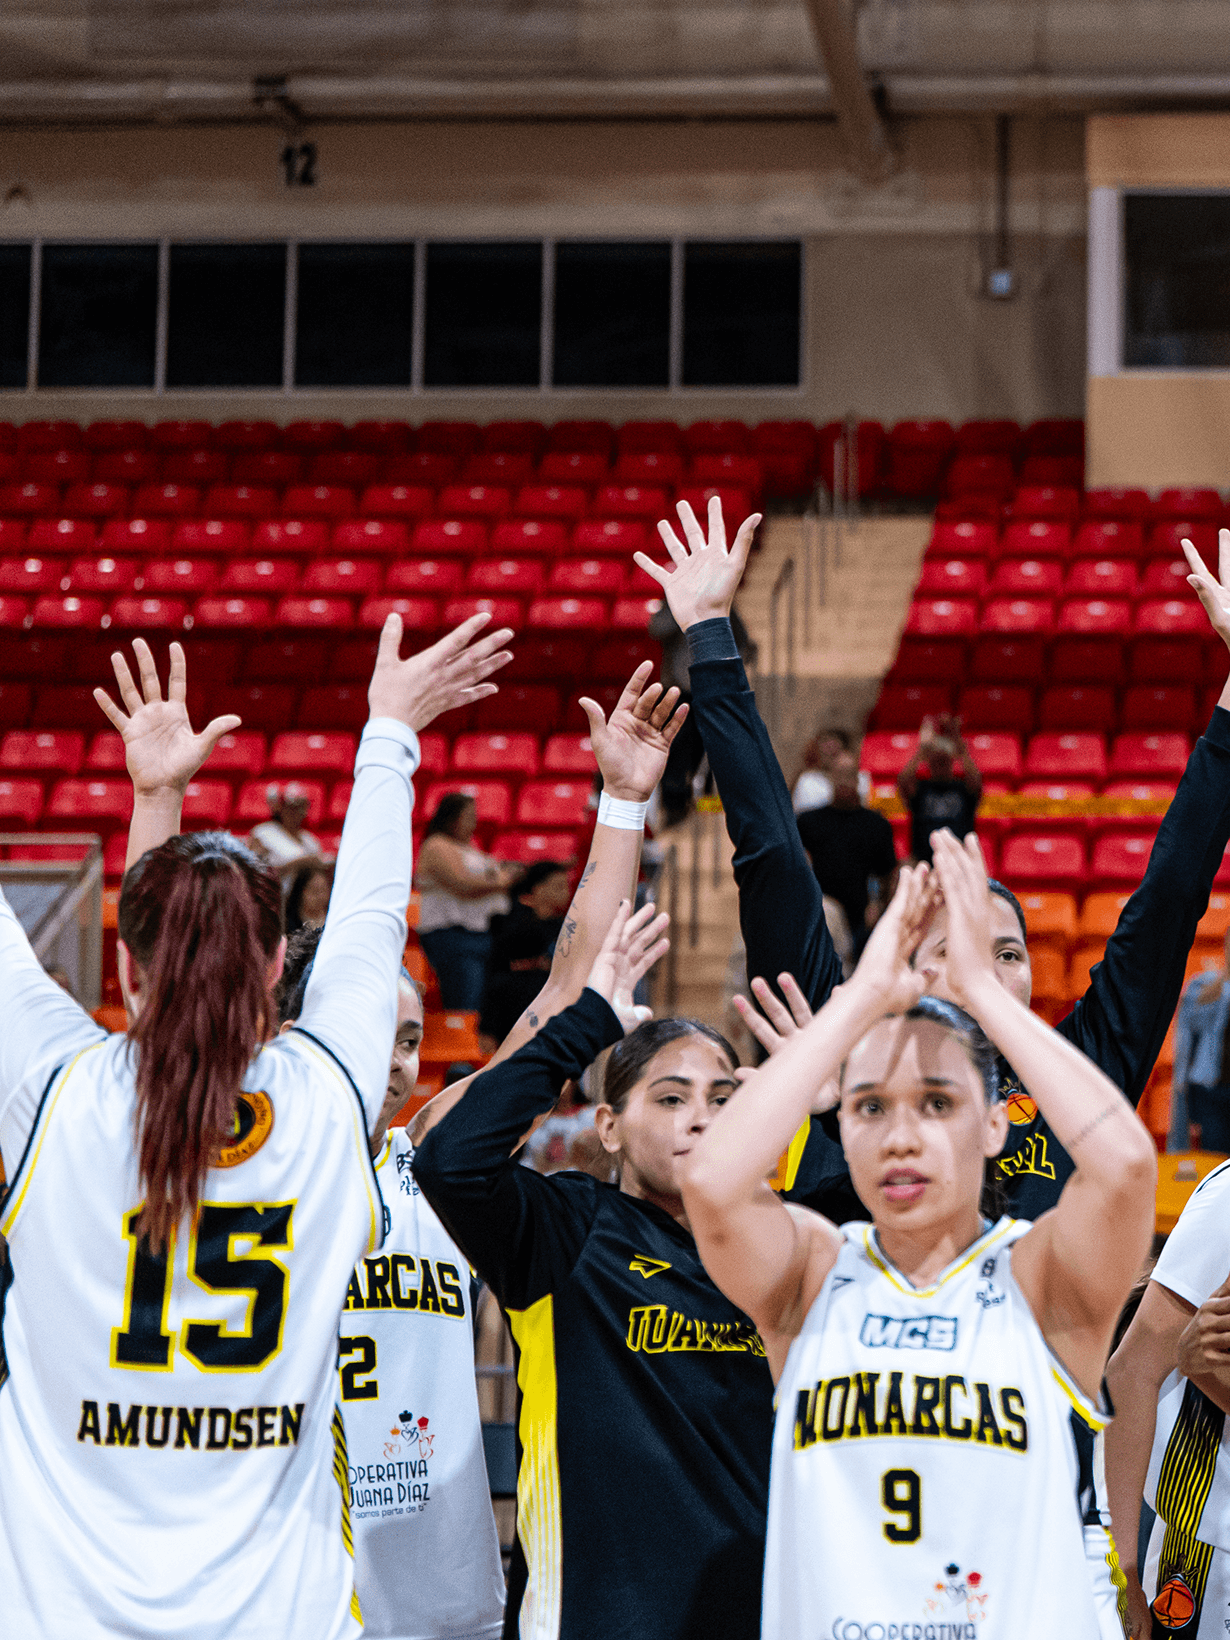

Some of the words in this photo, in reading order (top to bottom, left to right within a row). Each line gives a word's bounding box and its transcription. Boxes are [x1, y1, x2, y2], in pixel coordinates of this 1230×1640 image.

[280, 144, 317, 187] 12
[109, 1198, 298, 1374] 15
[858, 1313, 958, 1351] MCS
[339, 1335, 379, 1402] 2
[77, 1399, 304, 1451] AMUNDSEN
[792, 1371, 1029, 1453] MONARCAS
[349, 1486, 393, 1508] JUANA
[397, 1481, 430, 1504] DÍAZ
[879, 1467, 923, 1546] 9
